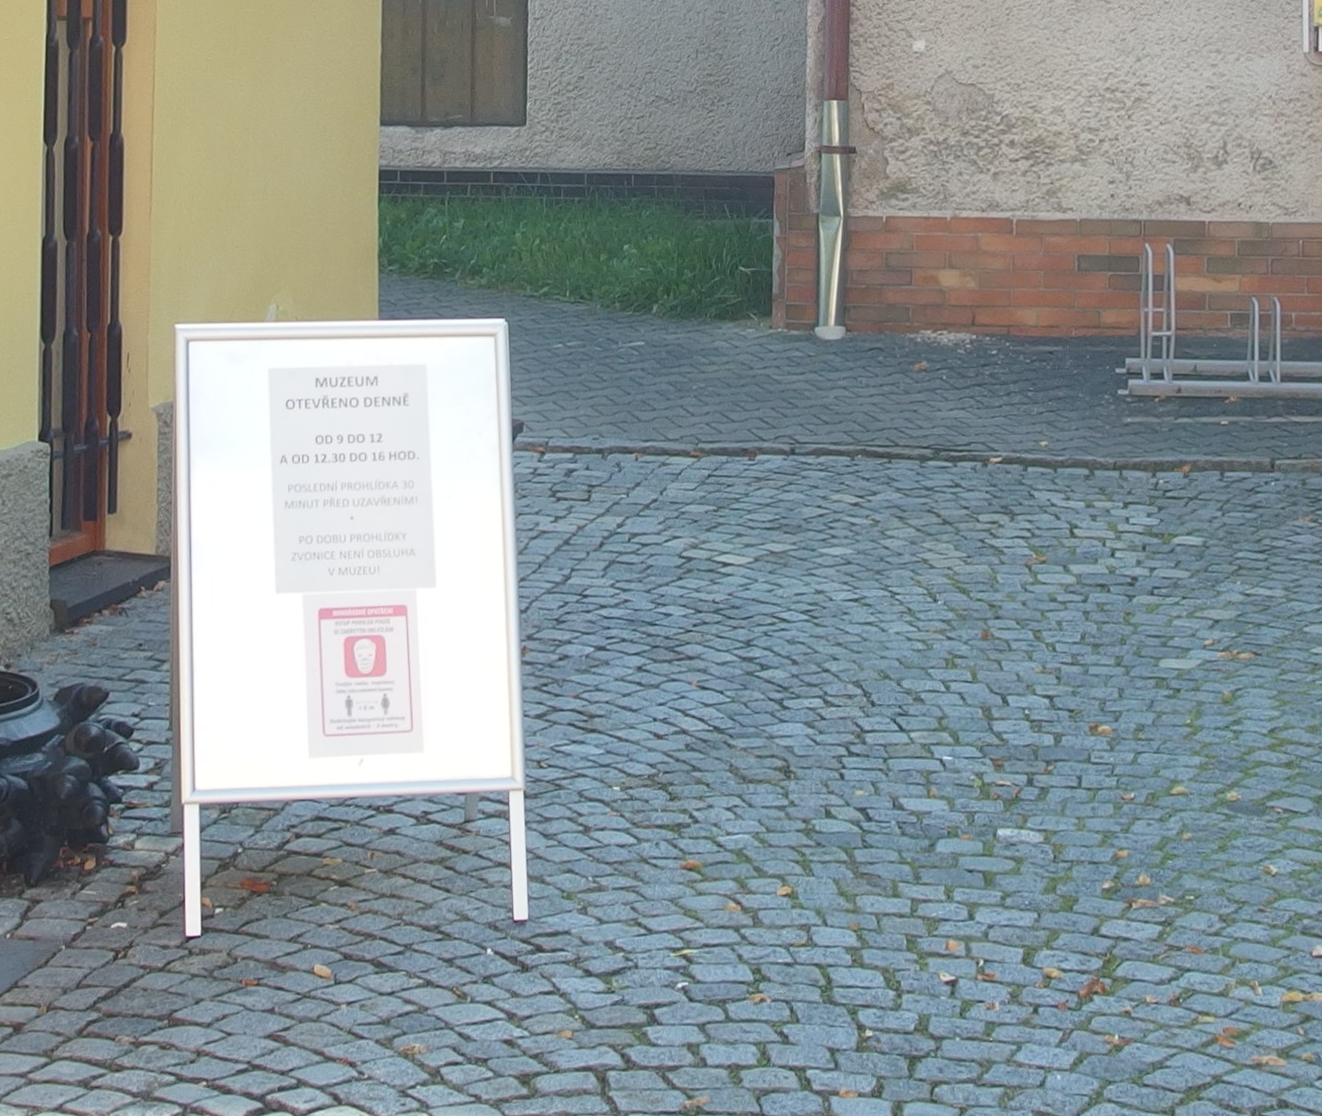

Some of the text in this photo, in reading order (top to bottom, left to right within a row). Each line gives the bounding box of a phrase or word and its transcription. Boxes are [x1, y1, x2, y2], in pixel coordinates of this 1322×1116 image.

[315, 375, 379, 388] MUZEUM
[285, 392, 410, 410] OTEVŘENO DENNĚ
[315, 432, 383, 445] OD 9 DO 12
[279, 450, 420, 465] A OD 12.30 DO 16 HOD.
[287, 478, 415, 493] POSLEDNÍ PROHLÍDKA 30
[284, 495, 419, 510] MINUT PŘED UZAVŘENÍM!
[299, 531, 407, 545] PO DOBU PROHLÍDKY
[291, 548, 416, 562] ZVONICE NENÍ OBSLUHA
[328, 566, 381, 576] V MUZEU!
